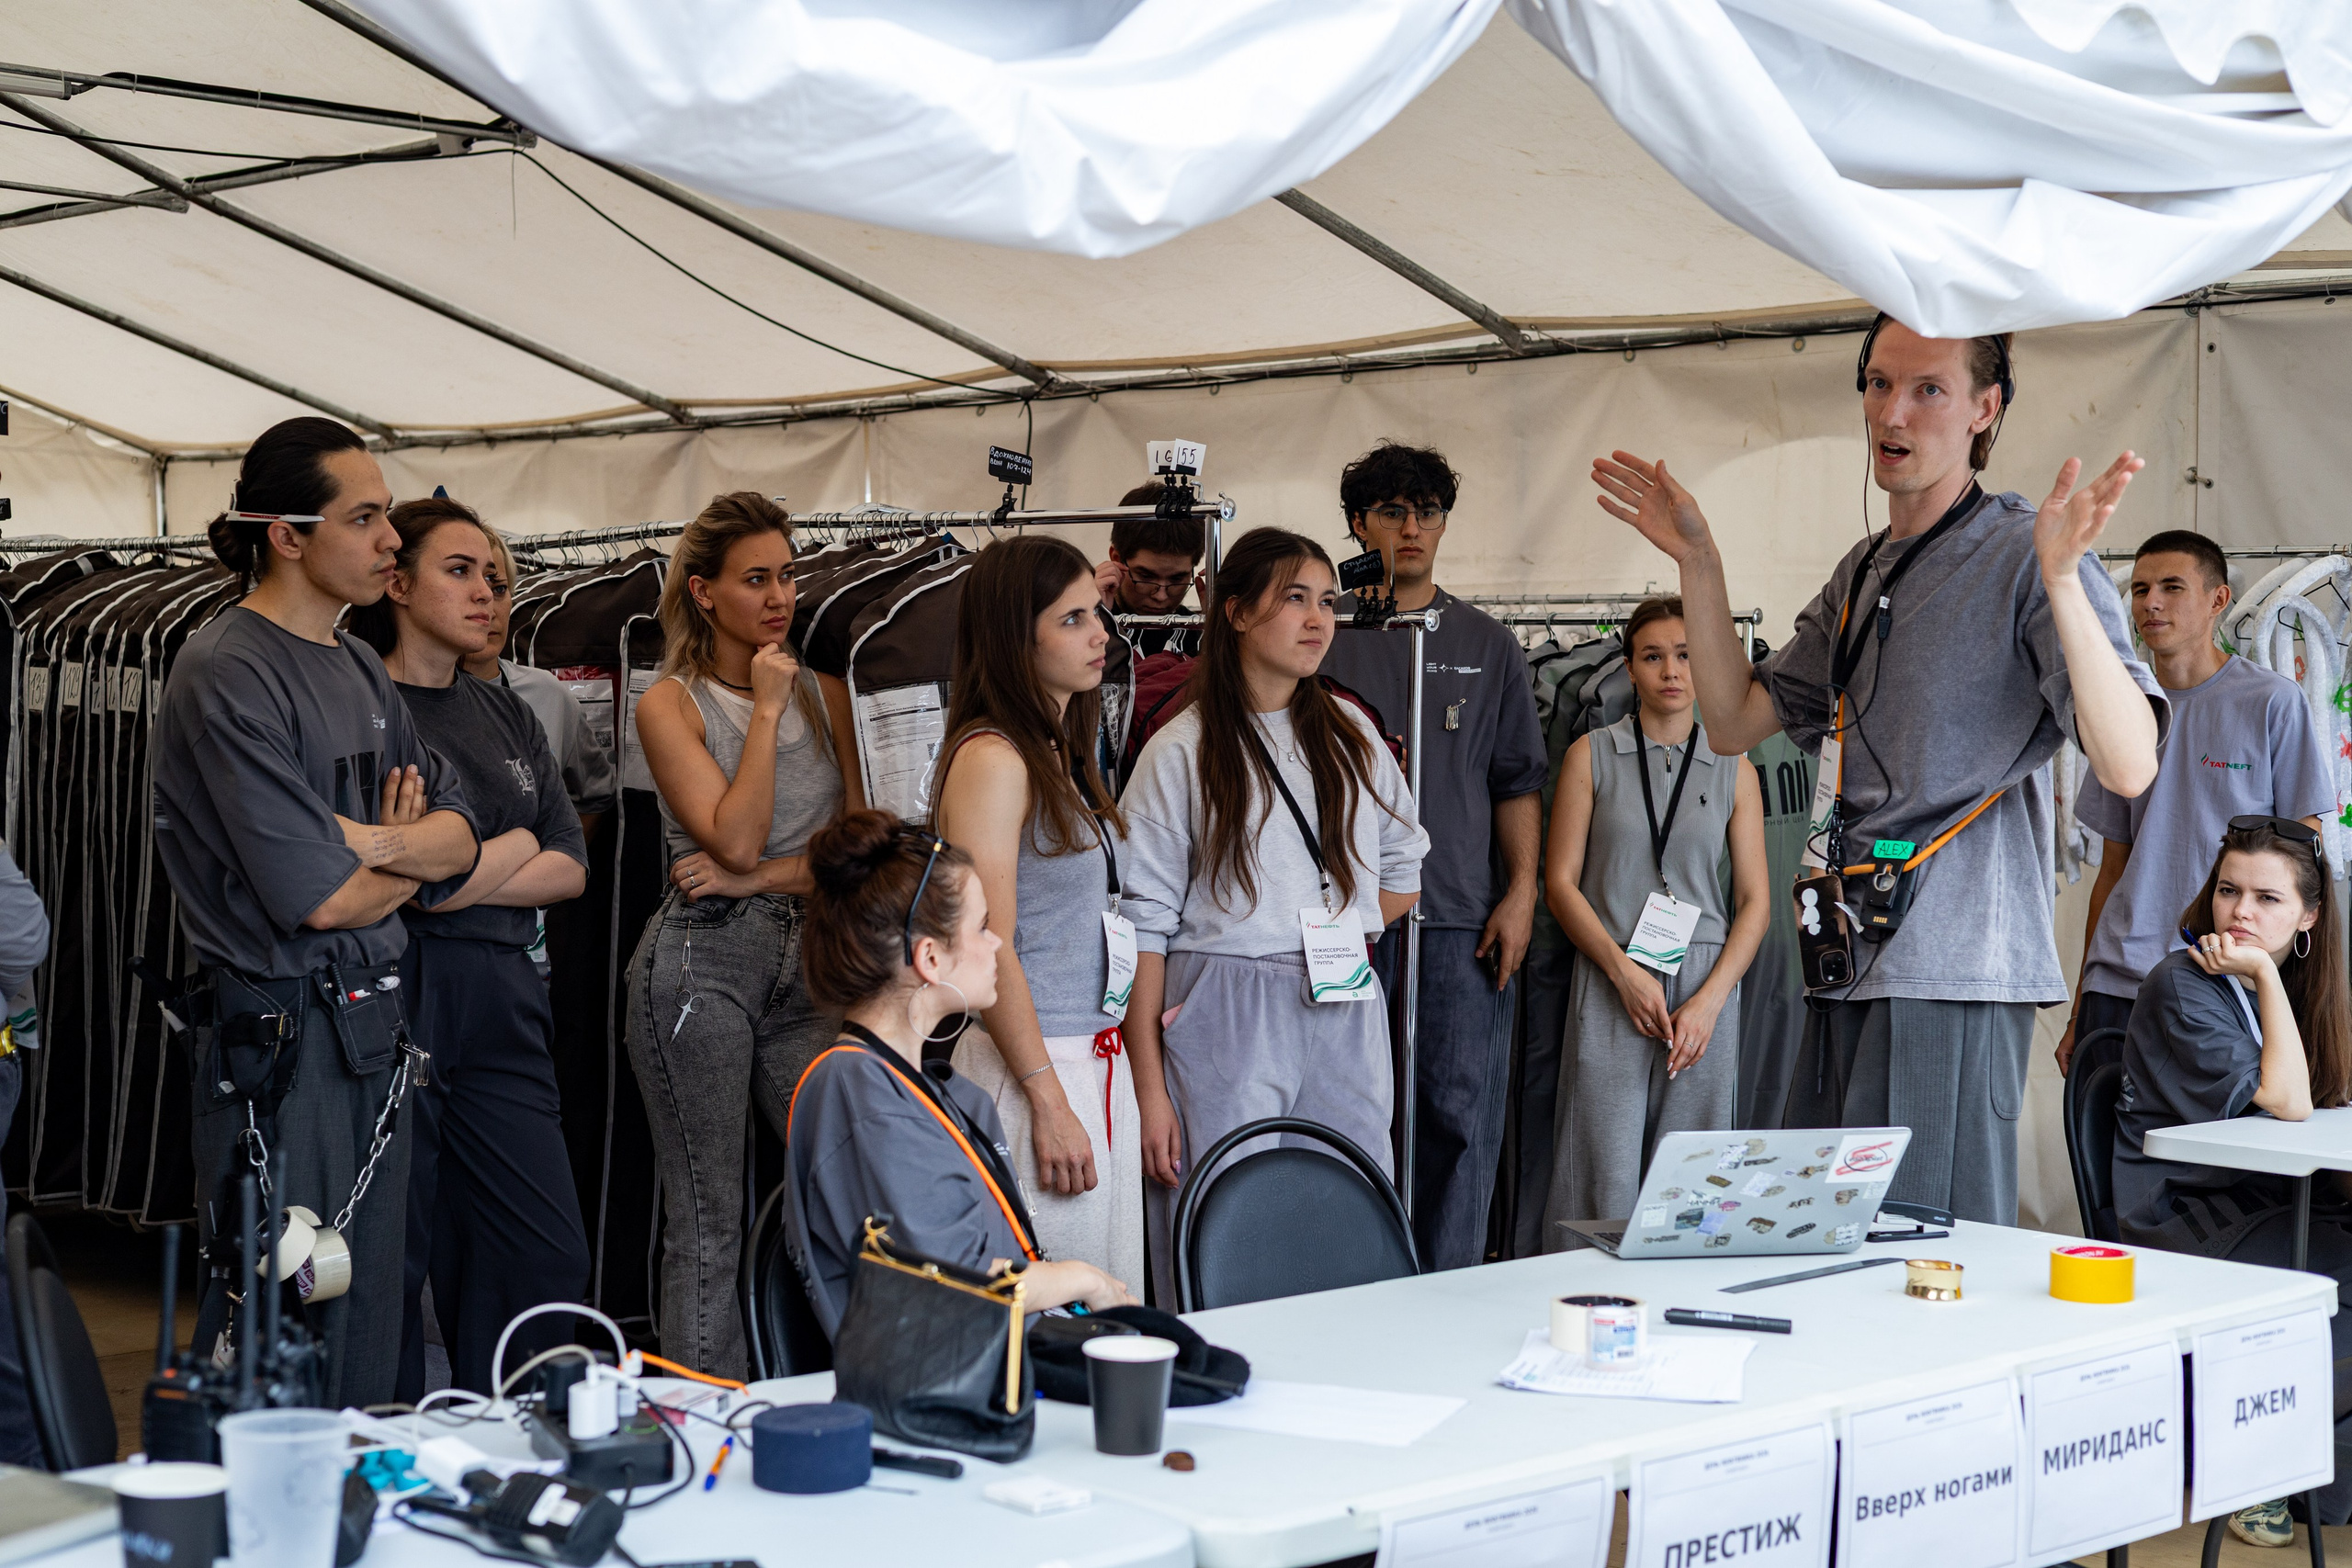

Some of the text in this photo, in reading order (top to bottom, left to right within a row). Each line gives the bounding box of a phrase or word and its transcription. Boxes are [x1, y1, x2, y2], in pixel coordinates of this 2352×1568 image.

[1177, 446, 1197, 465] 155
[66, 667, 82, 699] 129
[2210, 761, 2253, 771] TATNEFT
[1878, 842, 1910, 857] ALEX
[2234, 1385, 2296, 1429] ДЖЕМ
[2043, 1418, 2167, 1476] МИРИДАНС
[1856, 1465, 2013, 1522] Вверх ногами
[1664, 1513, 1803, 1568] ПРЕСТИЖ
